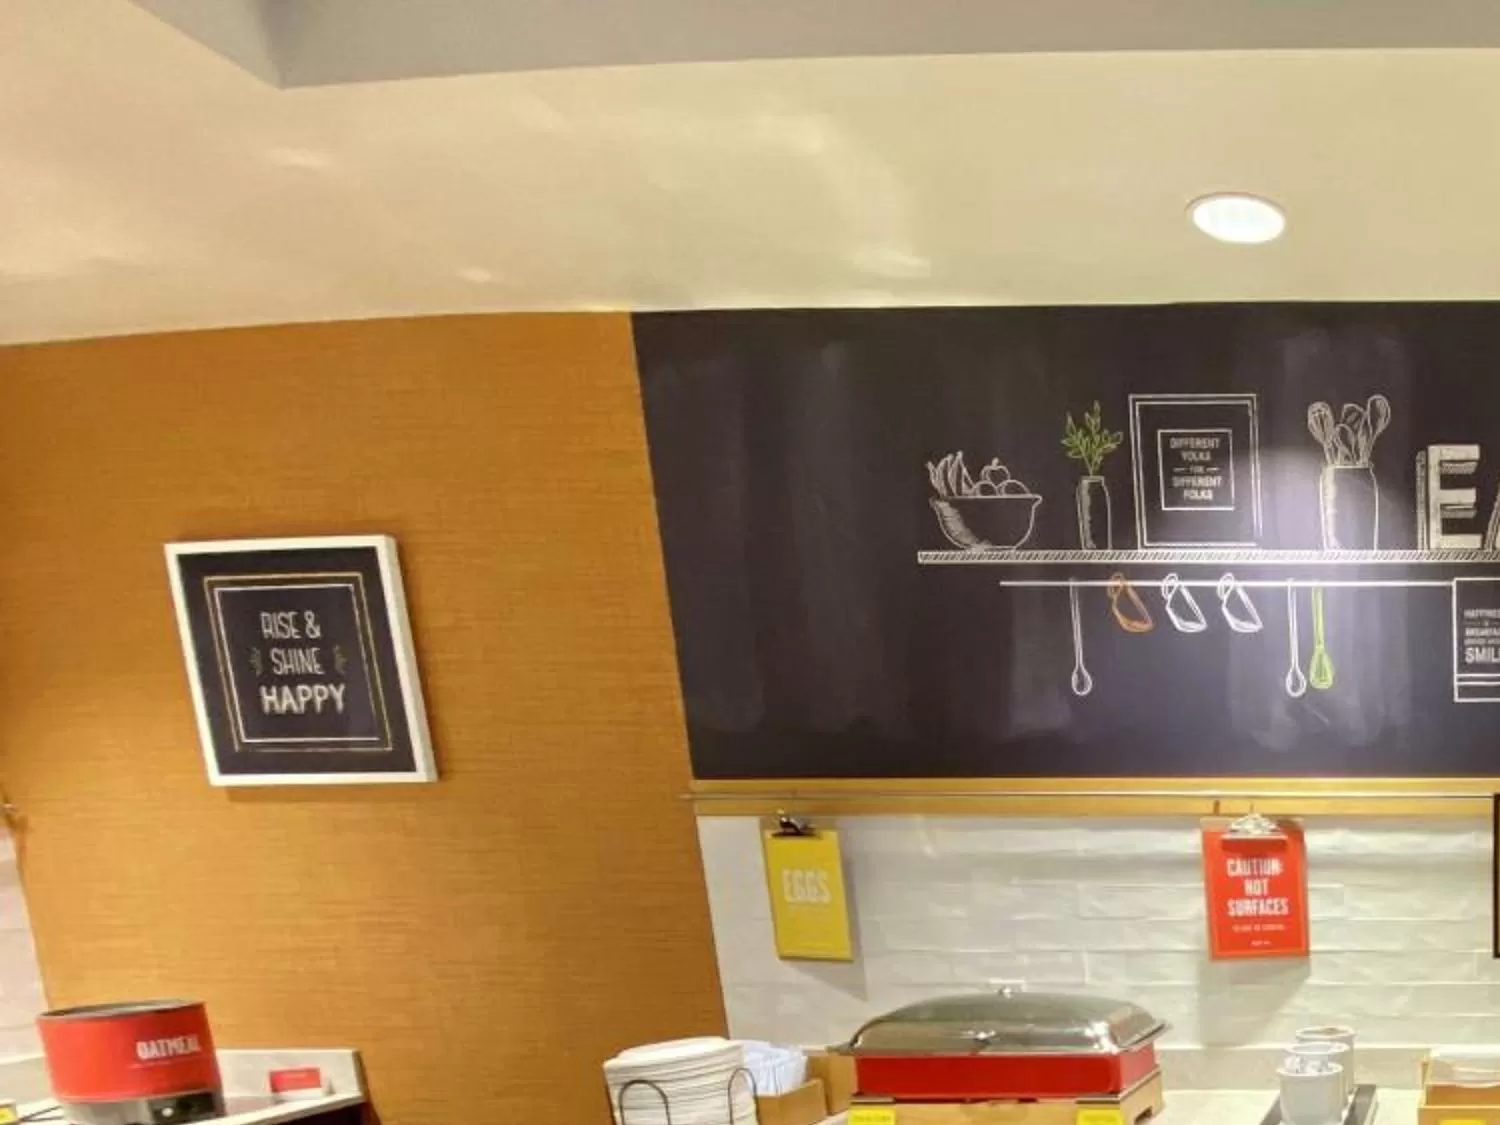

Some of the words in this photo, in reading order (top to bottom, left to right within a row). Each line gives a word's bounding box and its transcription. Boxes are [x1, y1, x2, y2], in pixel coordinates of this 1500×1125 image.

[260, 612, 301, 640] RISE
[304, 610, 322, 639] &
[271, 647, 326, 676] SHINE
[259, 684, 346, 714] HAPPY
[782, 868, 832, 905] EGGS
[1243, 878, 1270, 897] HOT
[1226, 897, 1290, 917] SURFACES
[135, 1034, 203, 1060] OATMEAL
